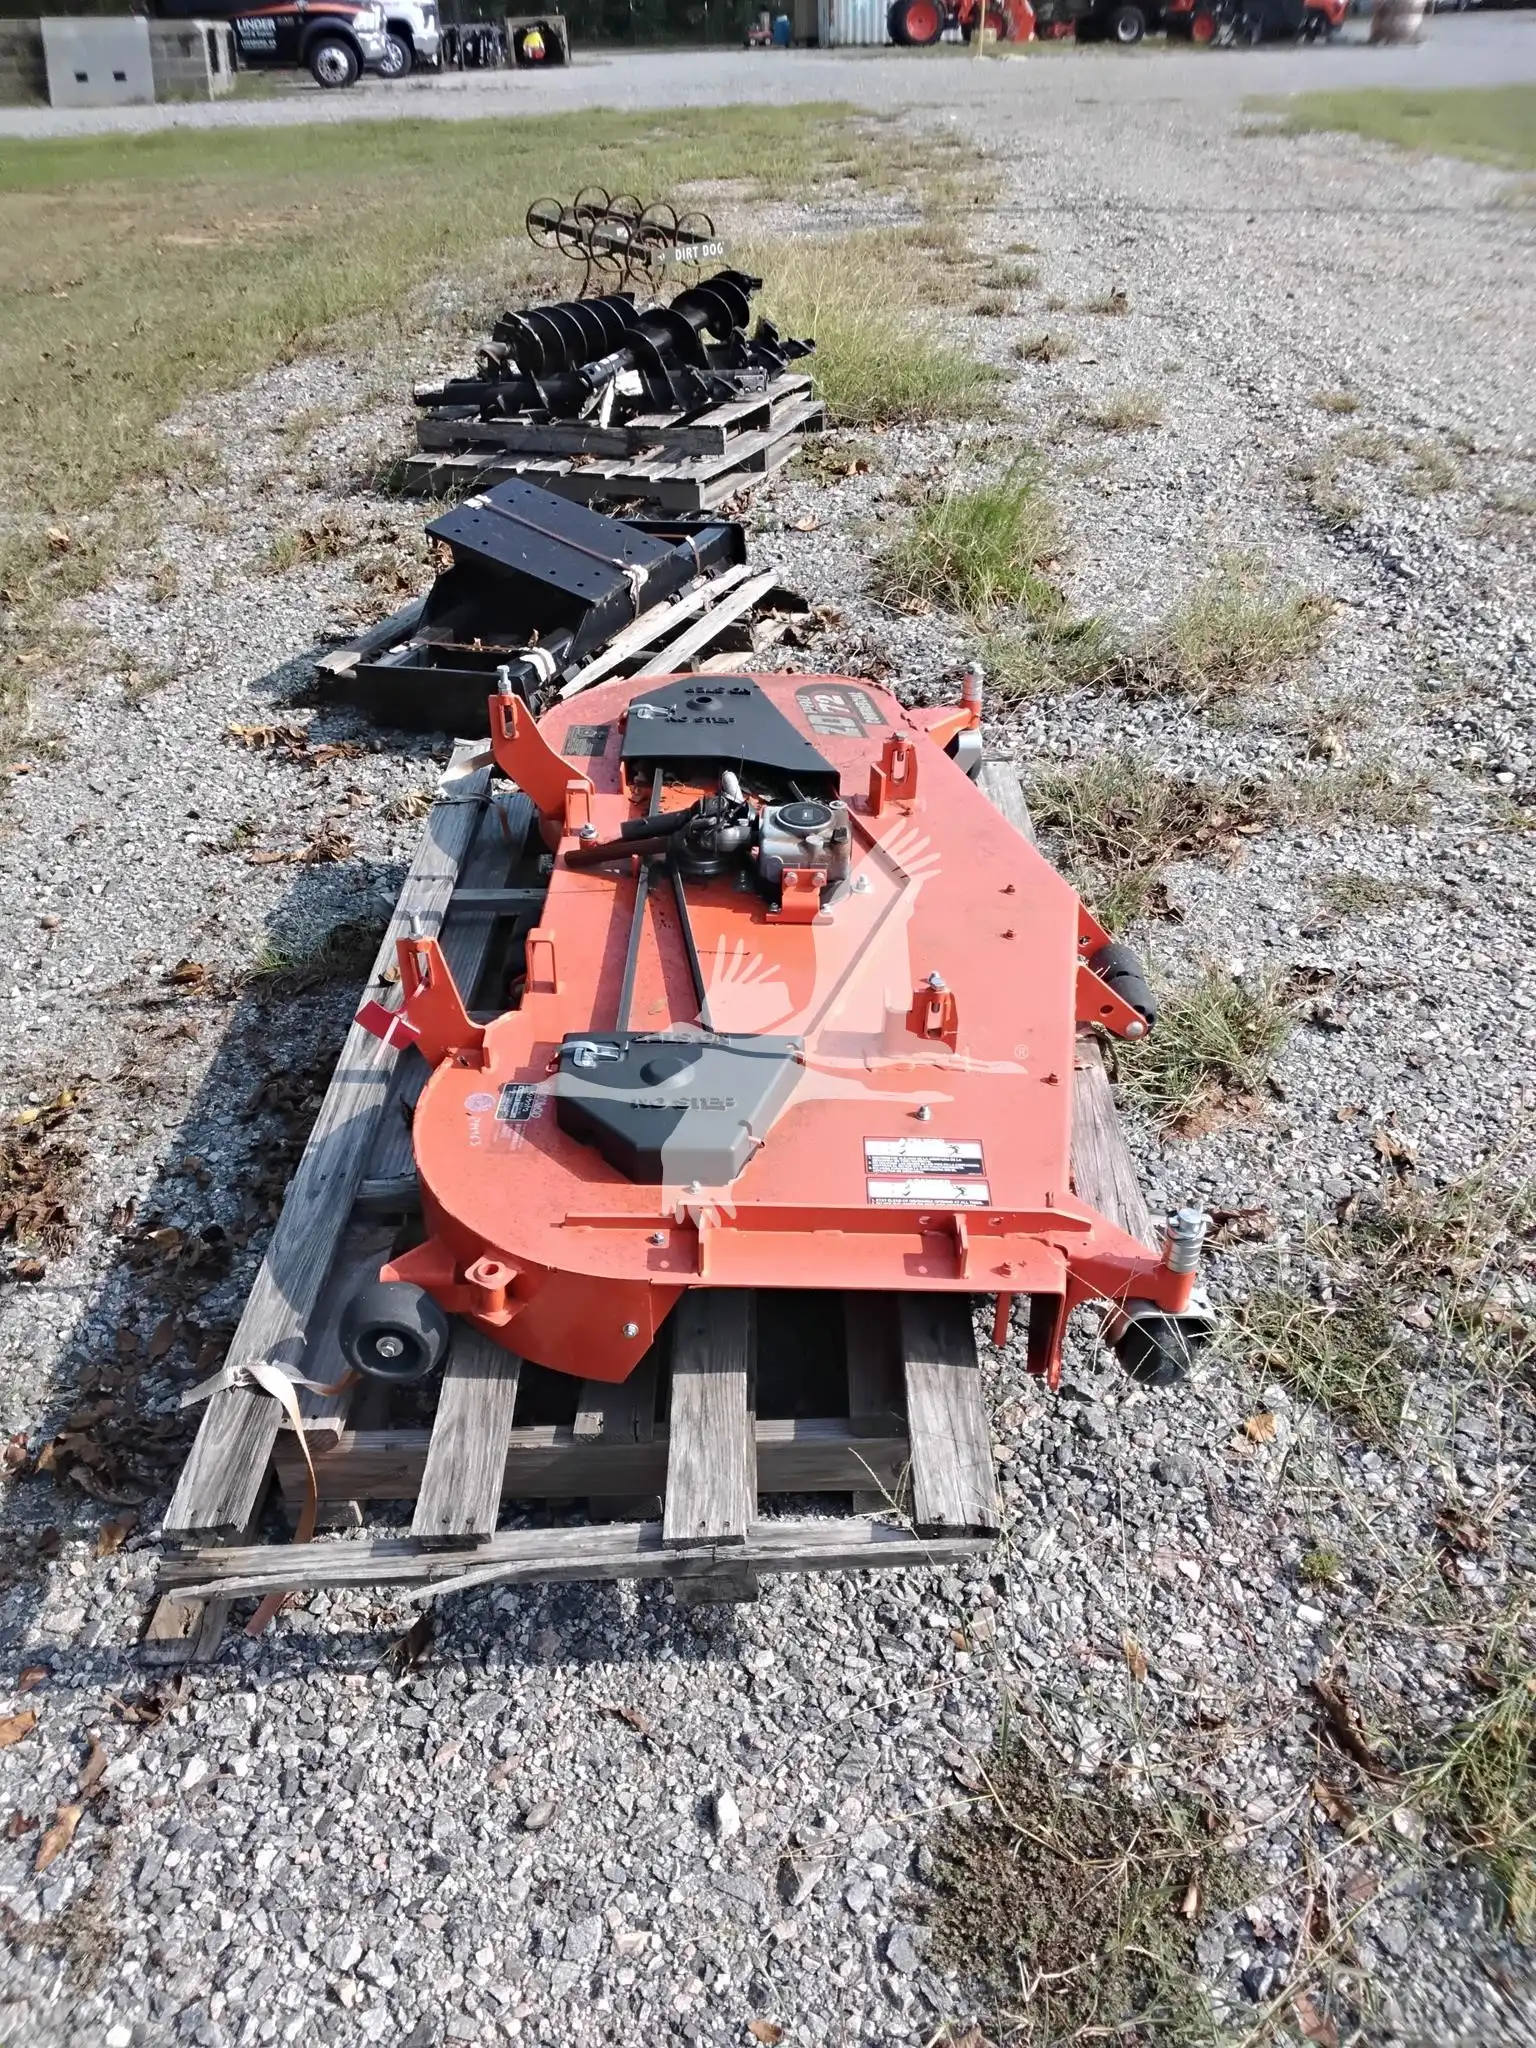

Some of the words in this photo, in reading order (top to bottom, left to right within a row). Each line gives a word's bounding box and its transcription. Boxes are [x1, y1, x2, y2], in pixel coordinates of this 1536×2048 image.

[675, 246, 699, 261] DIRT
[702, 242, 723, 257] DOG
[814, 694, 851, 714] 72
